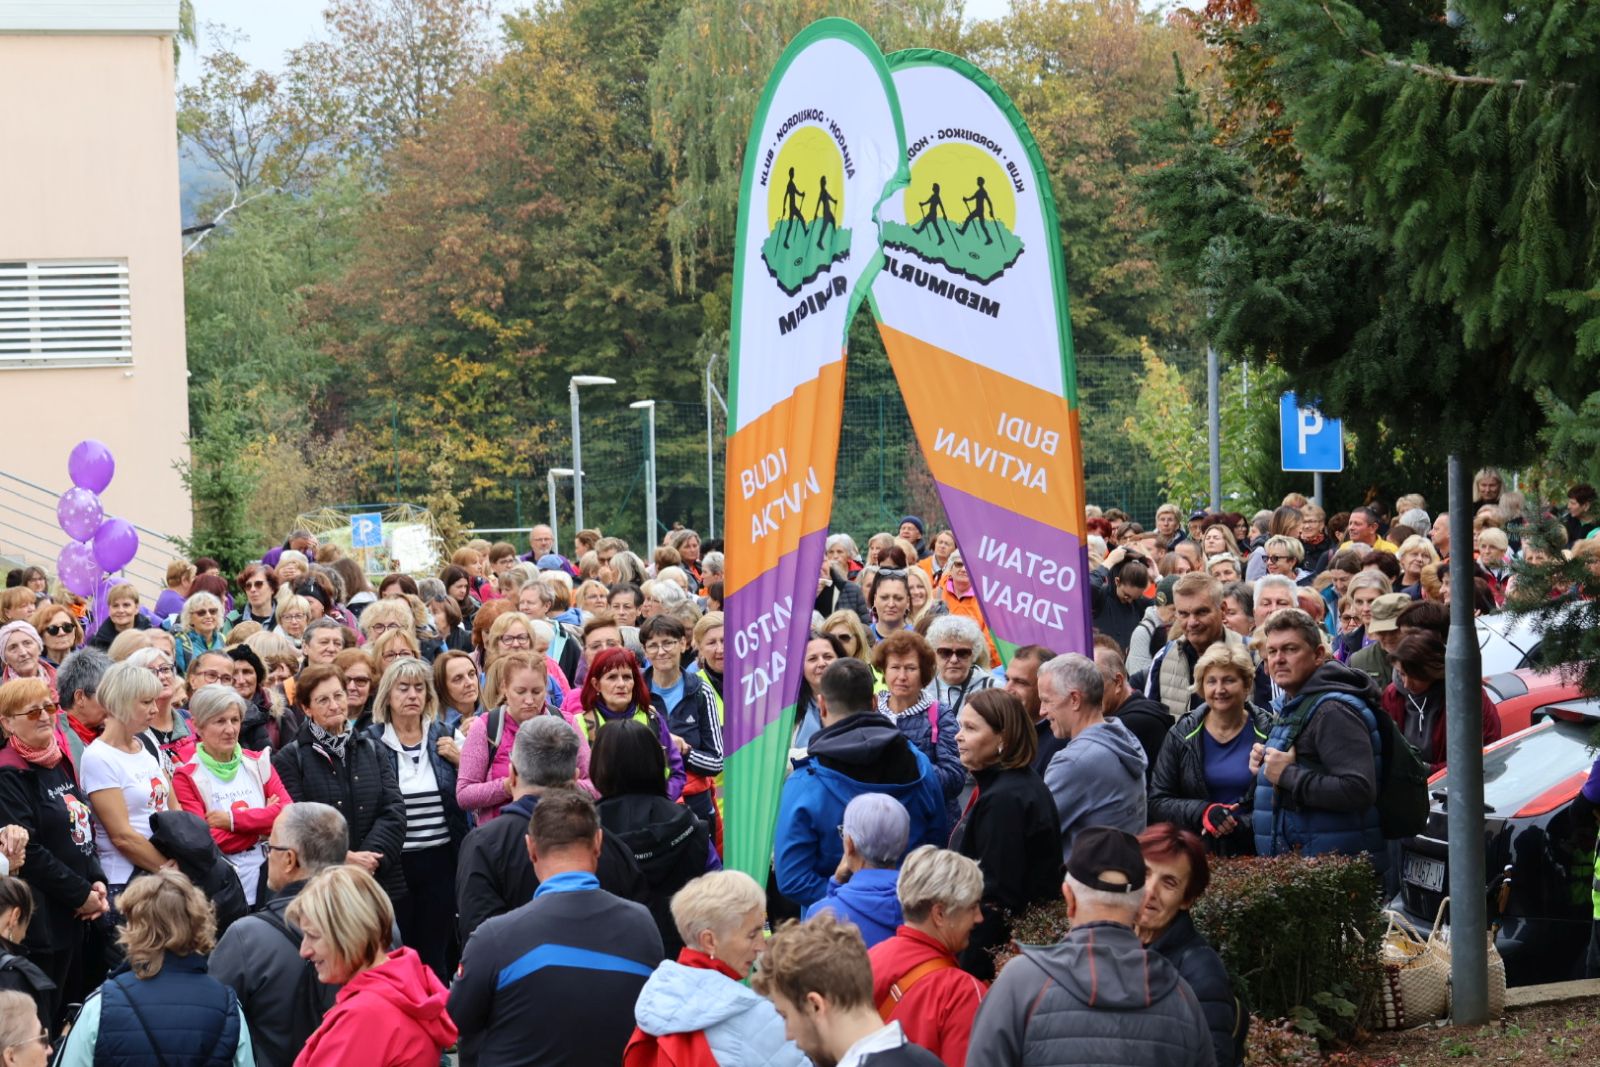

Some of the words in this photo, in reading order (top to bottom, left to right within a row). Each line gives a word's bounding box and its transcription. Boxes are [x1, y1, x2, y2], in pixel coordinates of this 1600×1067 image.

[761, 149, 774, 186] KLUB
[776, 109, 824, 142] NORDIJSKOG
[829, 119, 855, 180] HODANJA
[1297, 407, 1324, 455] P
[740, 447, 788, 500] BUDI
[360, 519, 373, 542] P
